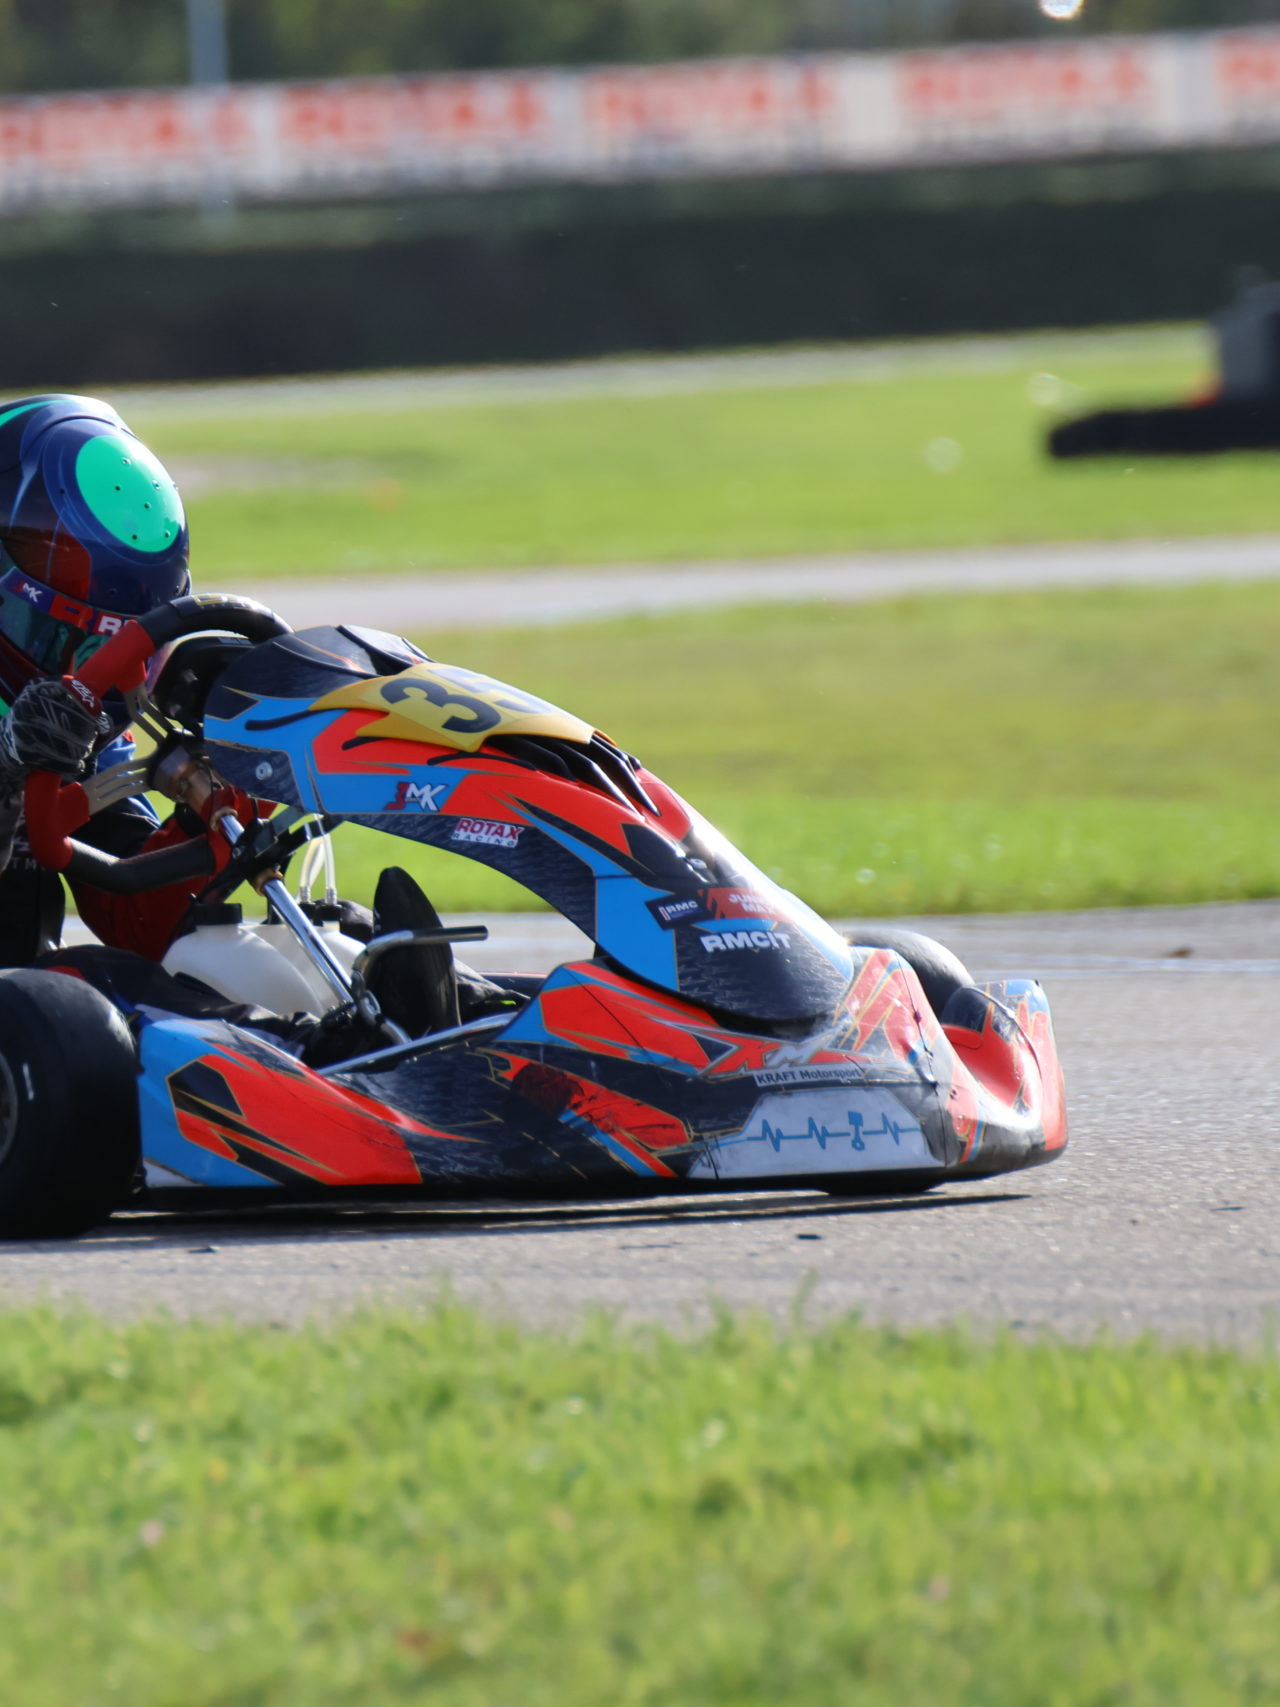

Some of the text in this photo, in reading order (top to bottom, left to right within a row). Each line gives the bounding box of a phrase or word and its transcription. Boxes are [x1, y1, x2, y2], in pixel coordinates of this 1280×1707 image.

[456, 818, 523, 841] ROTAX
[451, 832, 517, 848] RACING
[665, 900, 699, 915] RMC
[700, 930, 792, 953] RMCIT
[756, 1067, 862, 1085] KRAFT Motorsport
